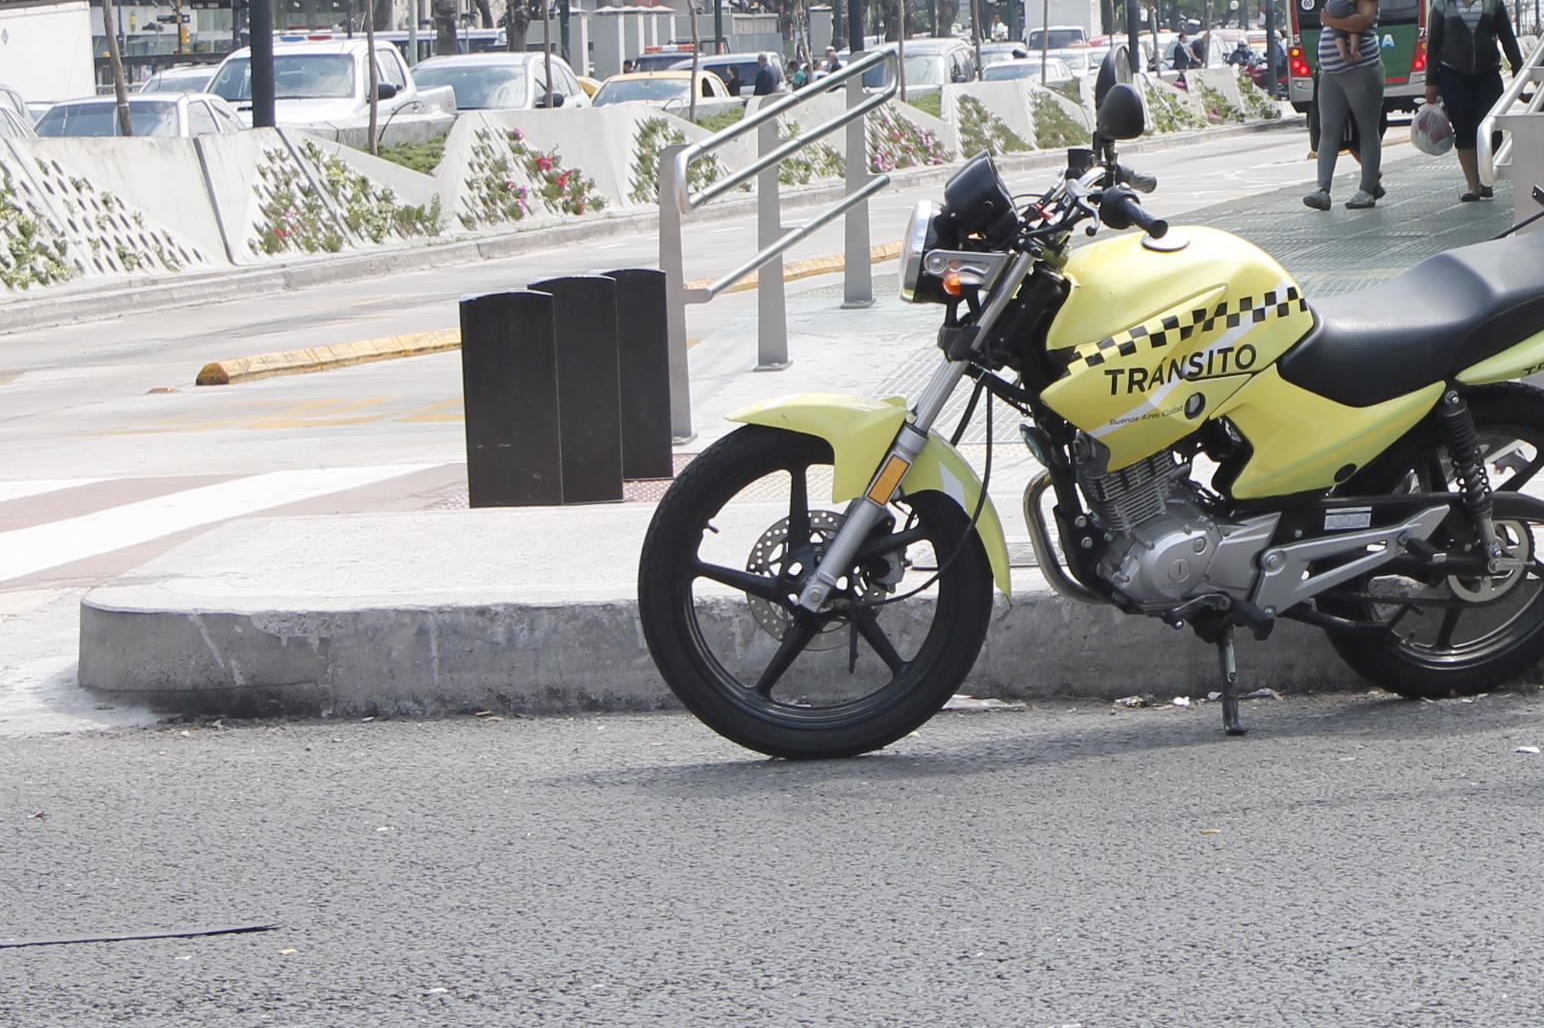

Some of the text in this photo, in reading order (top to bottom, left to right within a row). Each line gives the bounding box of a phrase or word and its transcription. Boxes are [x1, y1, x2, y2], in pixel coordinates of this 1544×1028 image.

[1104, 344, 1257, 396] TRÁNSITO
[1109, 404, 1184, 426] Buenos Aires Ciudad
